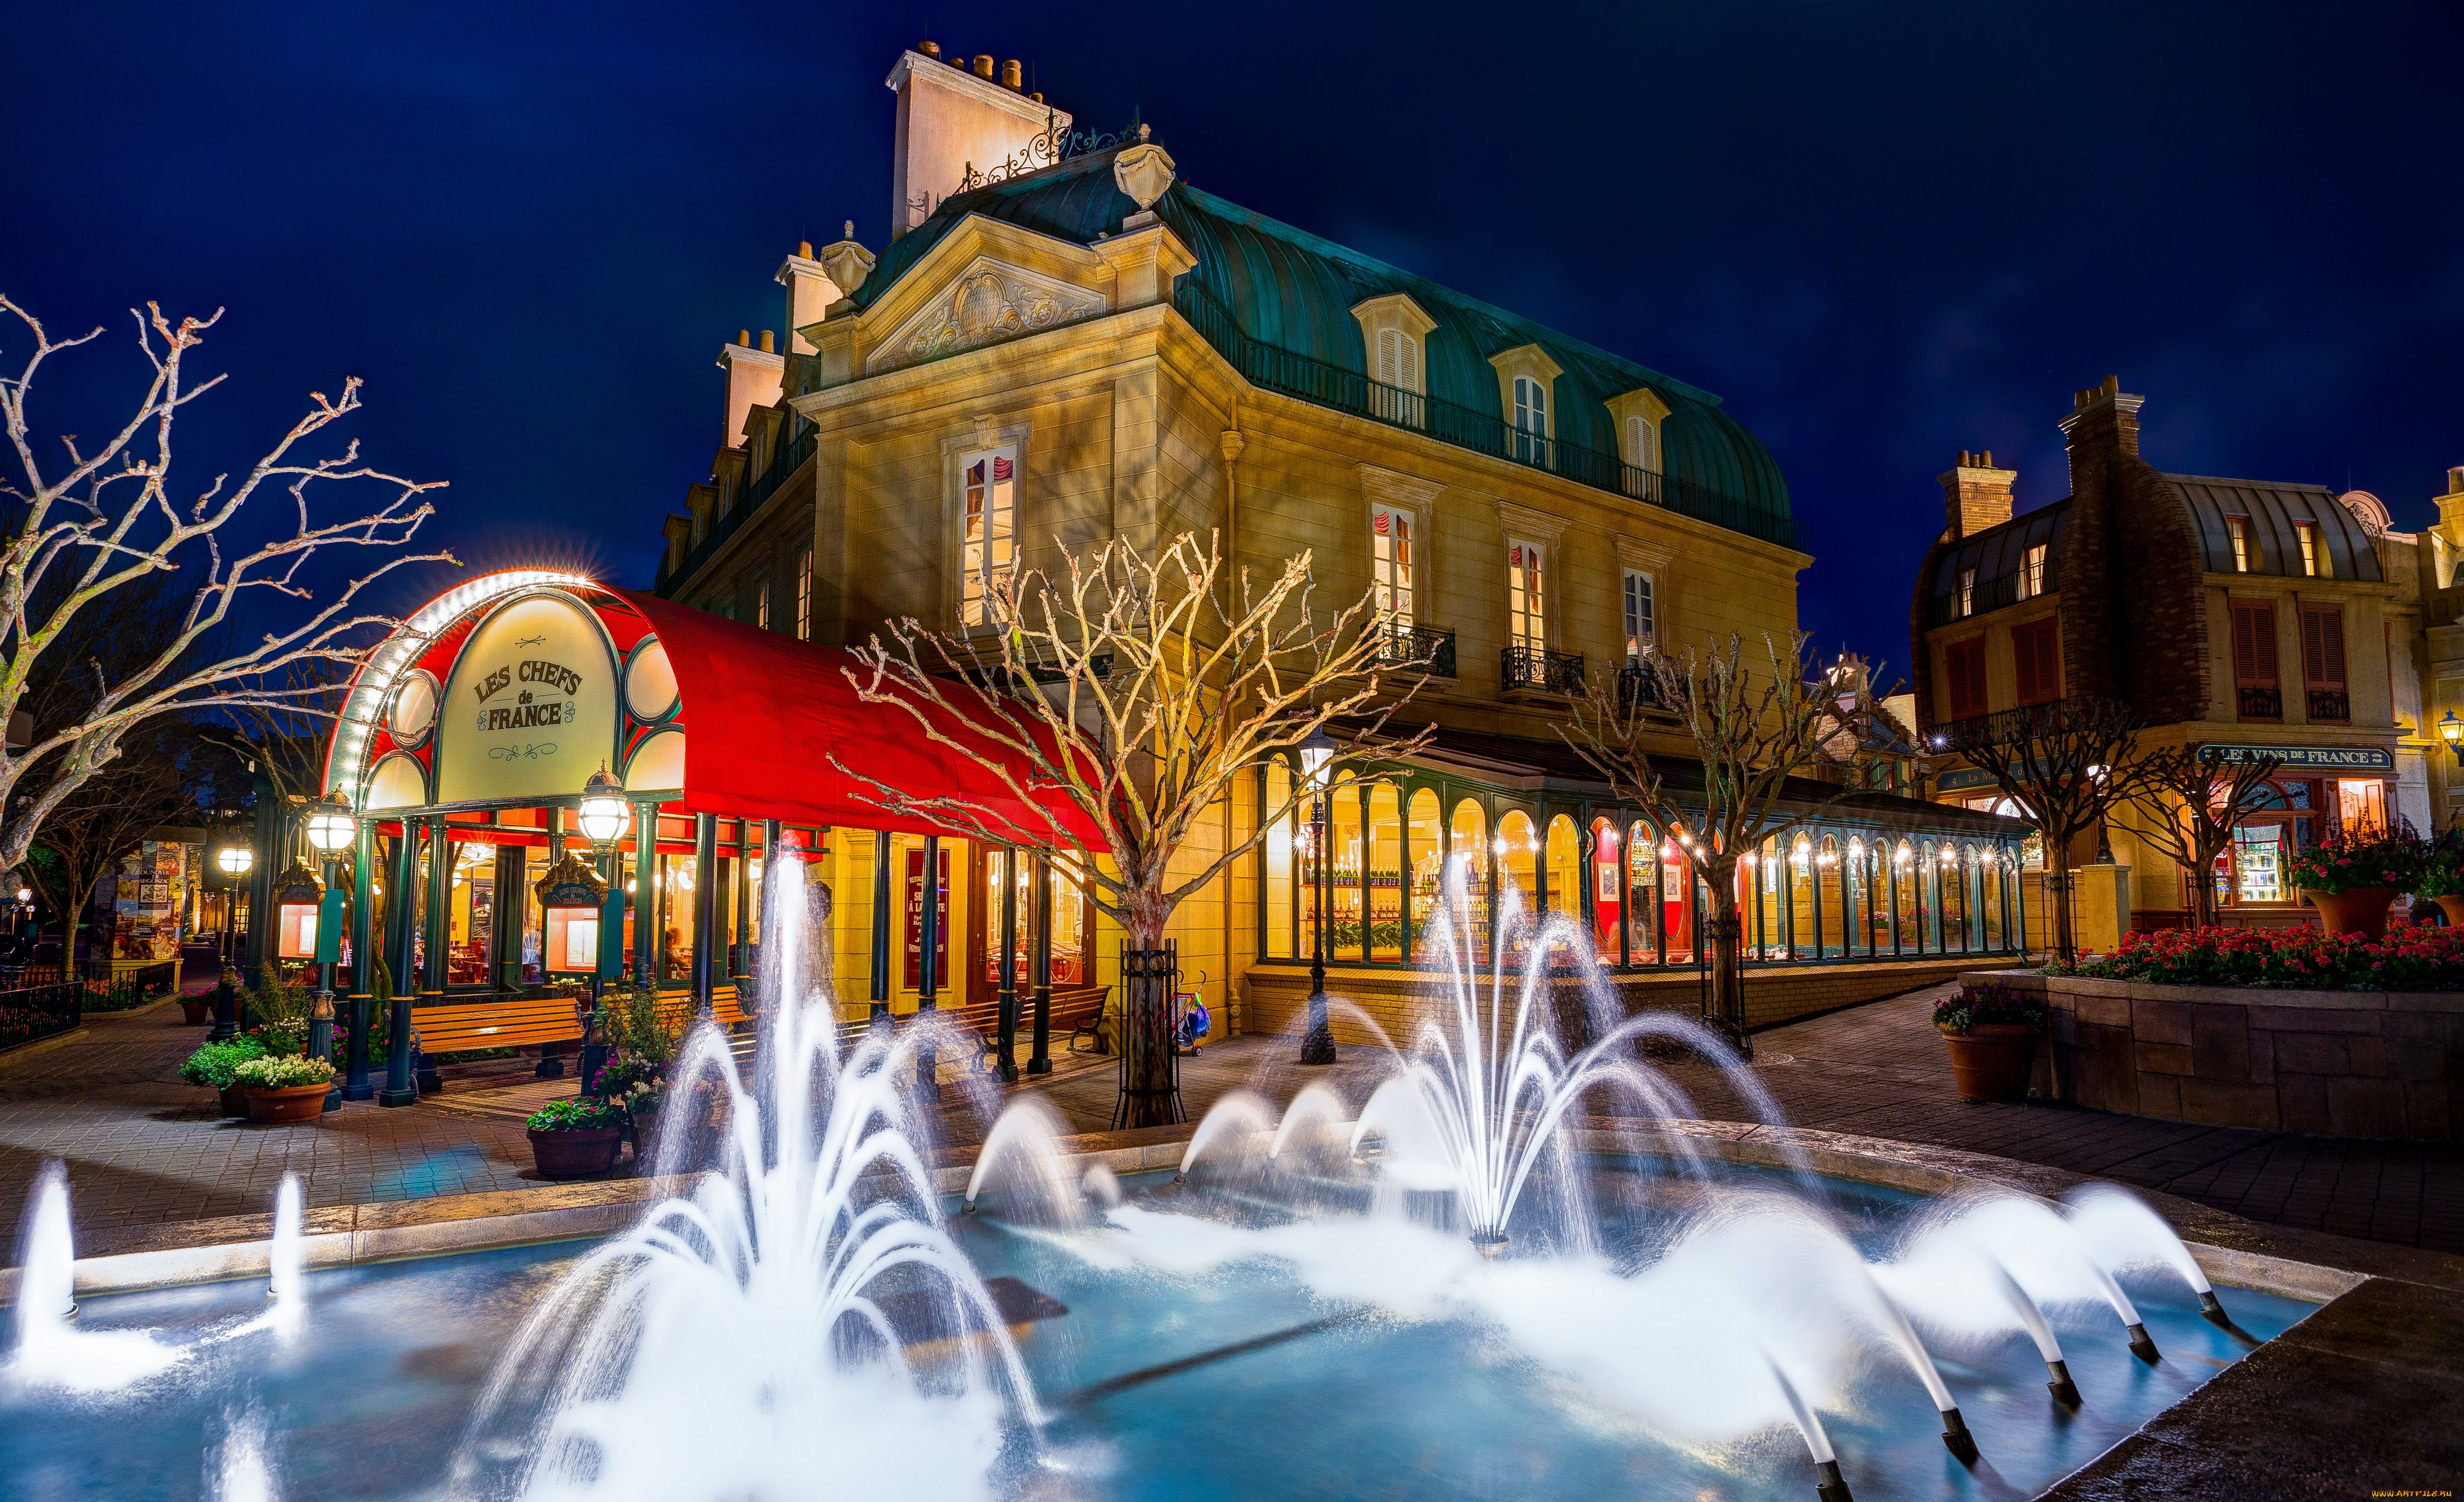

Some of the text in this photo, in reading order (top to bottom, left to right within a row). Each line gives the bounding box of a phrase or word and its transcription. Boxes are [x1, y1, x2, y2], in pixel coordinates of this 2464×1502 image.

[474, 660, 583, 705] LES CHEFS
[518, 689, 533, 704] de
[487, 702, 562, 730] FRANCE
[2307, 751, 2369, 763] FRANCE
[1951, 777, 1957, 786] 4
[1968, 774, 1978, 782] La
